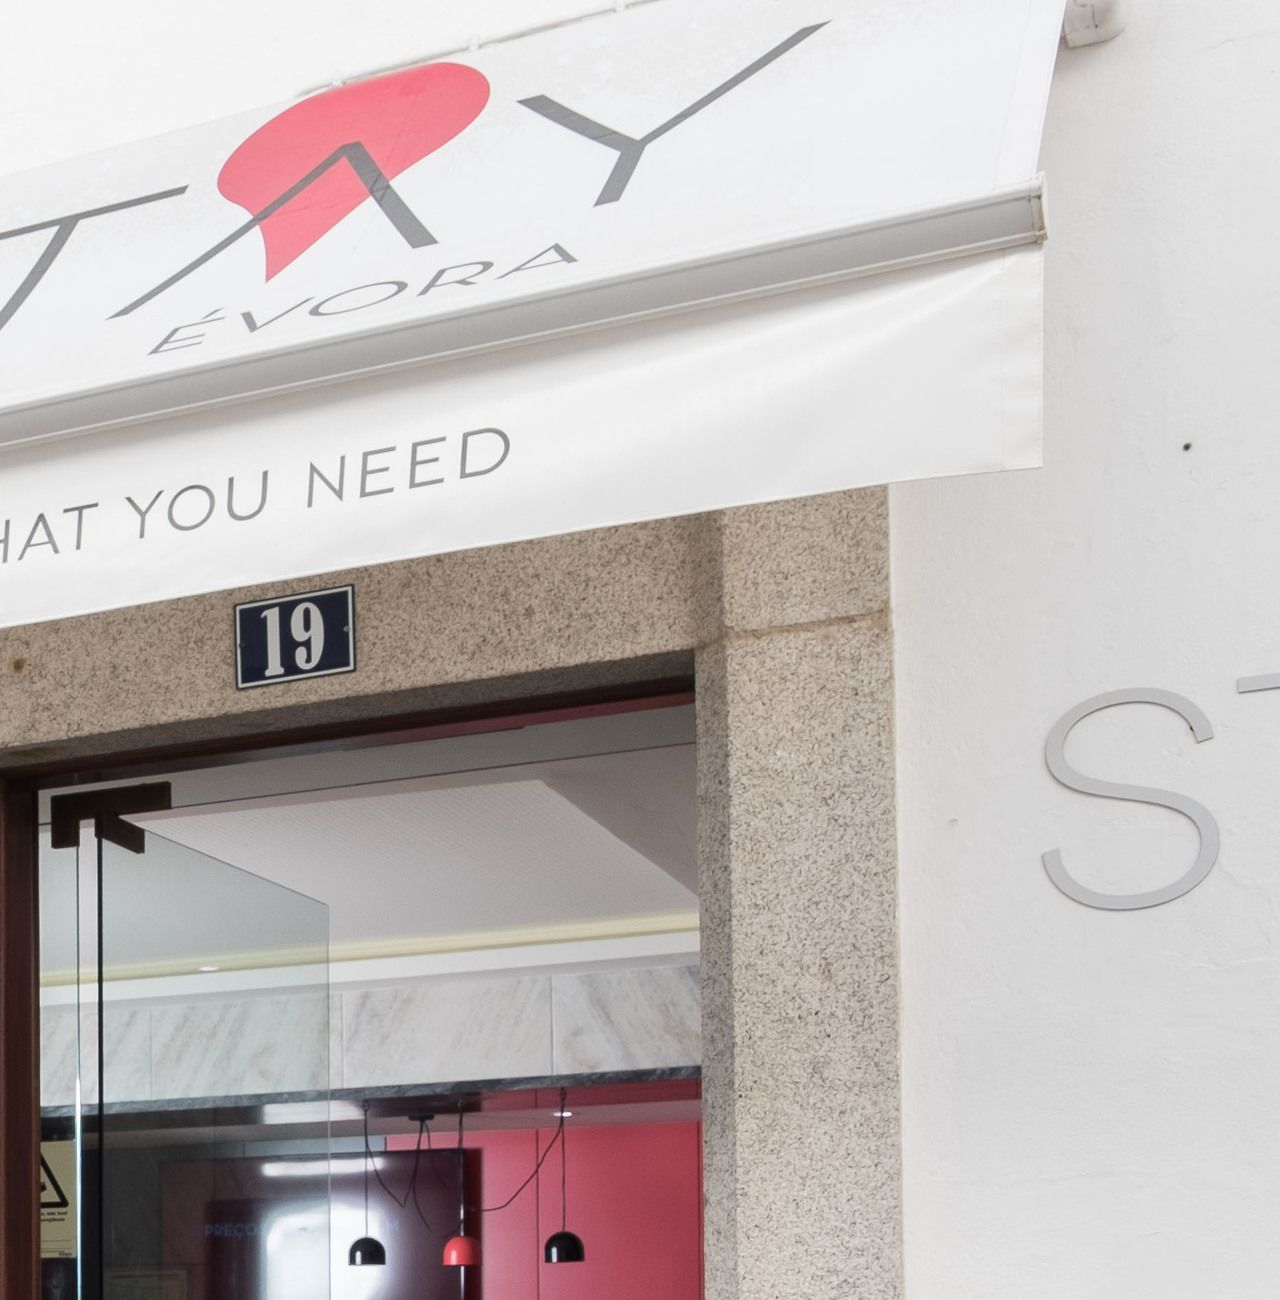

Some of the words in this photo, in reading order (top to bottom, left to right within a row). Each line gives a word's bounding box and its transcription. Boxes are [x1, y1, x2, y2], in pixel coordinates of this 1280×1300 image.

[147, 242, 578, 356] ÉVORA
[125, 470, 269, 540] YOU
[307, 427, 511, 508] NEED
[260, 602, 325, 677] 19
[1042, 673, 1280, 911] S
